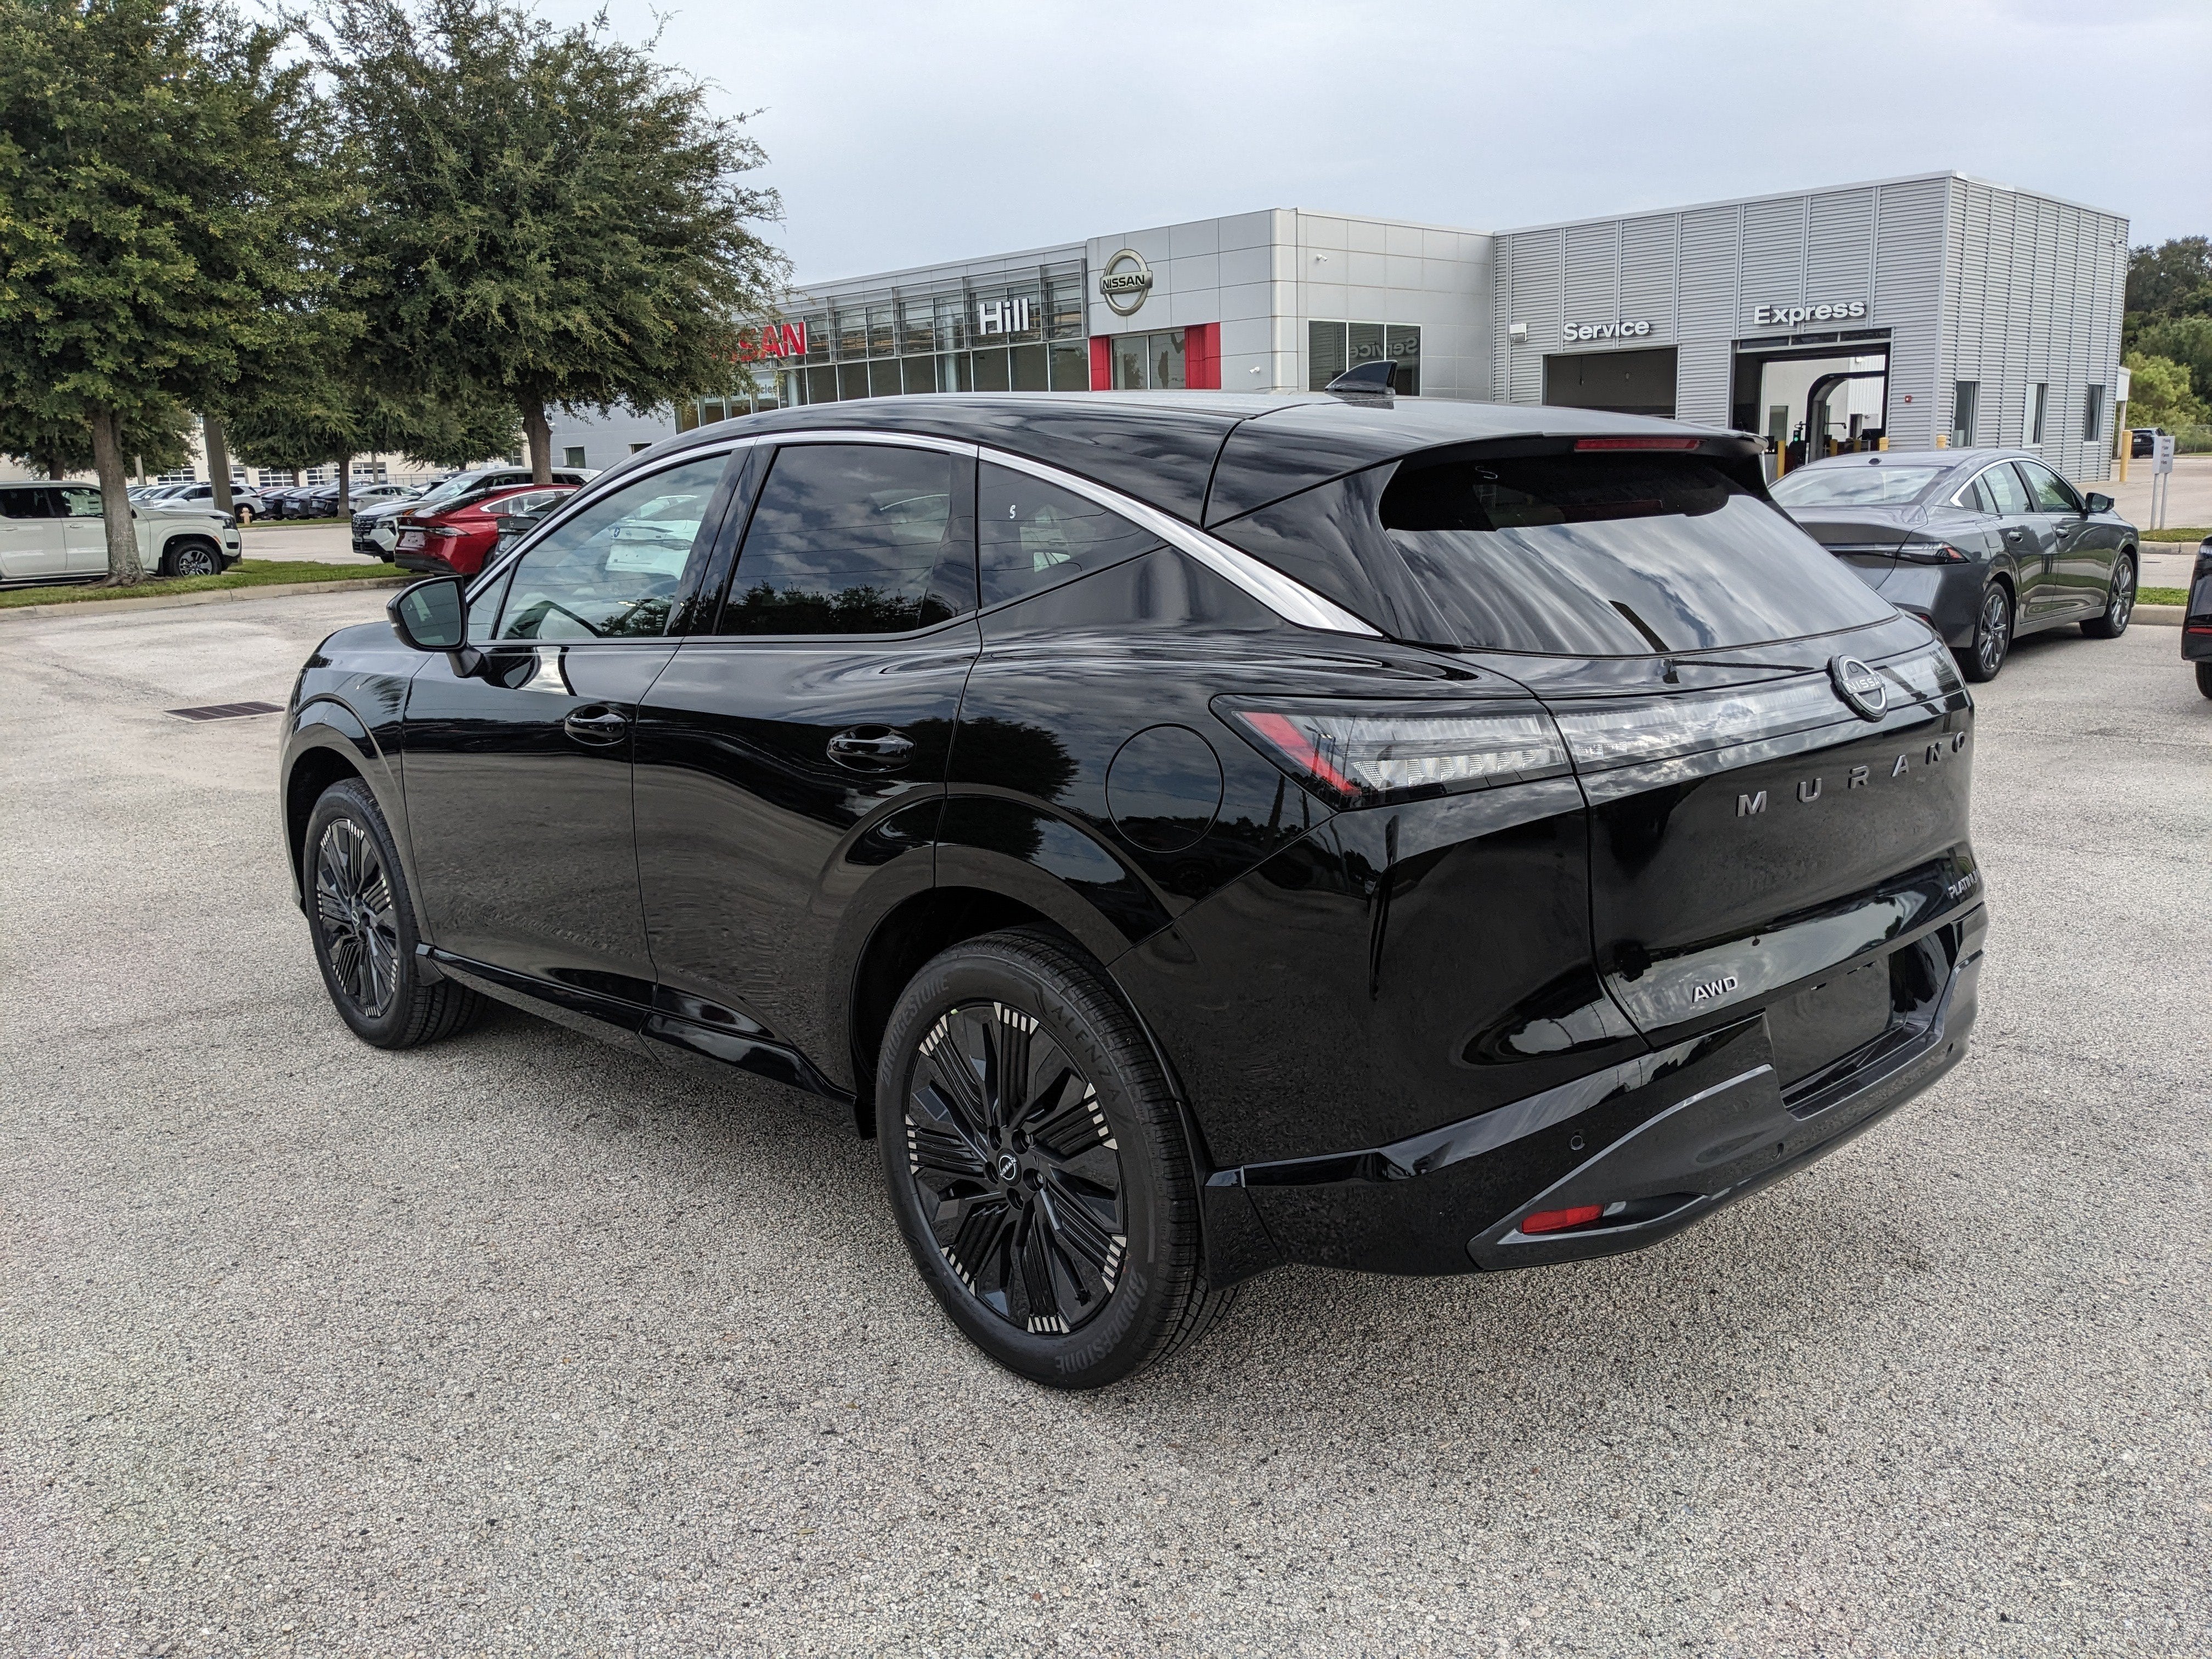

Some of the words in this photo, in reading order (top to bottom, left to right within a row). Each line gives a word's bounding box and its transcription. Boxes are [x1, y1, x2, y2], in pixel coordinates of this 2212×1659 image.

[1103, 275, 1145, 289] NISSAN
[979, 298, 1029, 335] Hill
[1753, 301, 1866, 326] Express
[1563, 319, 1650, 341] Service
[1845, 676, 1882, 691] NISSA
[1736, 731, 1965, 817] MURANO
[1692, 976, 1738, 1003] AWD
[881, 978, 949, 1088] BRIDGESTONE
[1051, 1006, 1121, 1102] ALENZA
[1000, 1156, 1017, 1177] NISSAN
